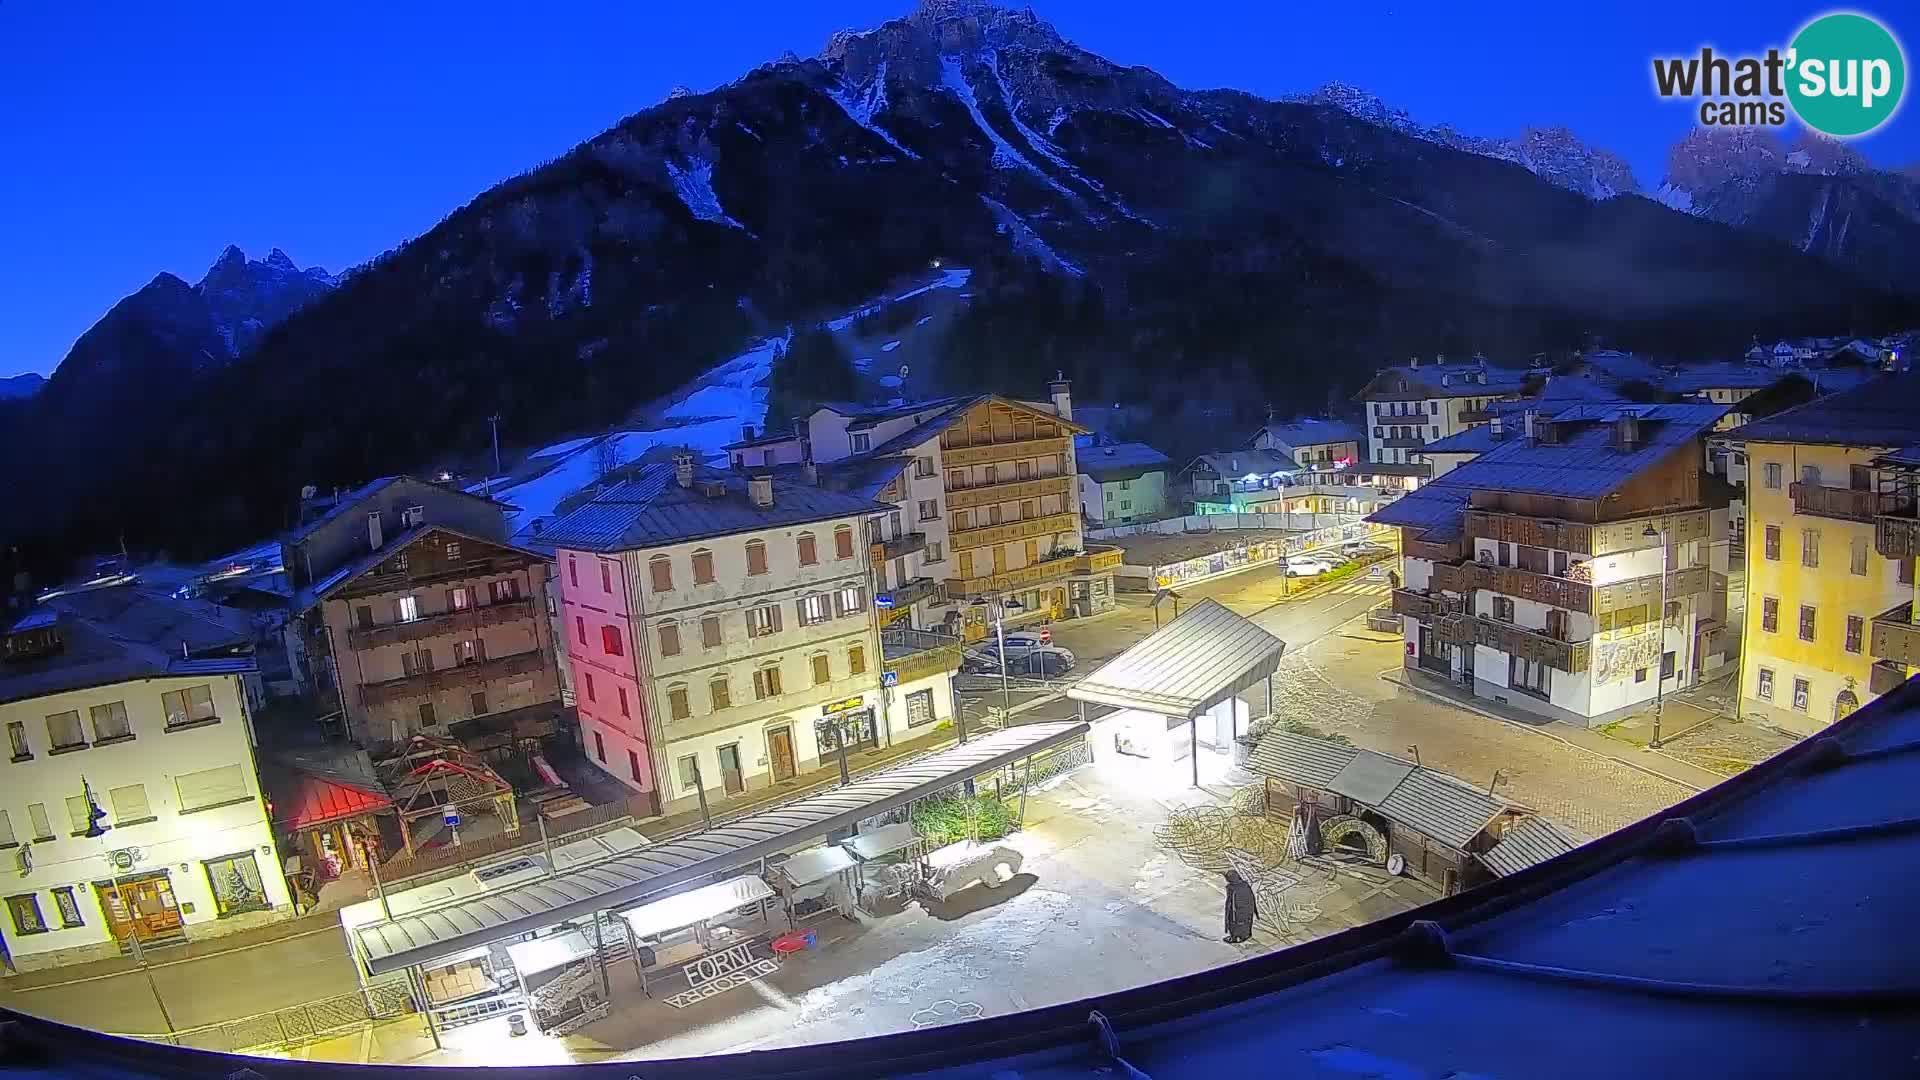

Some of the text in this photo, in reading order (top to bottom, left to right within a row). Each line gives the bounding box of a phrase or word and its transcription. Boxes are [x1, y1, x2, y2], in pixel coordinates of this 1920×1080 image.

[663, 959, 780, 1009] DI SOPRA
[682, 940, 760, 987] FORNI
